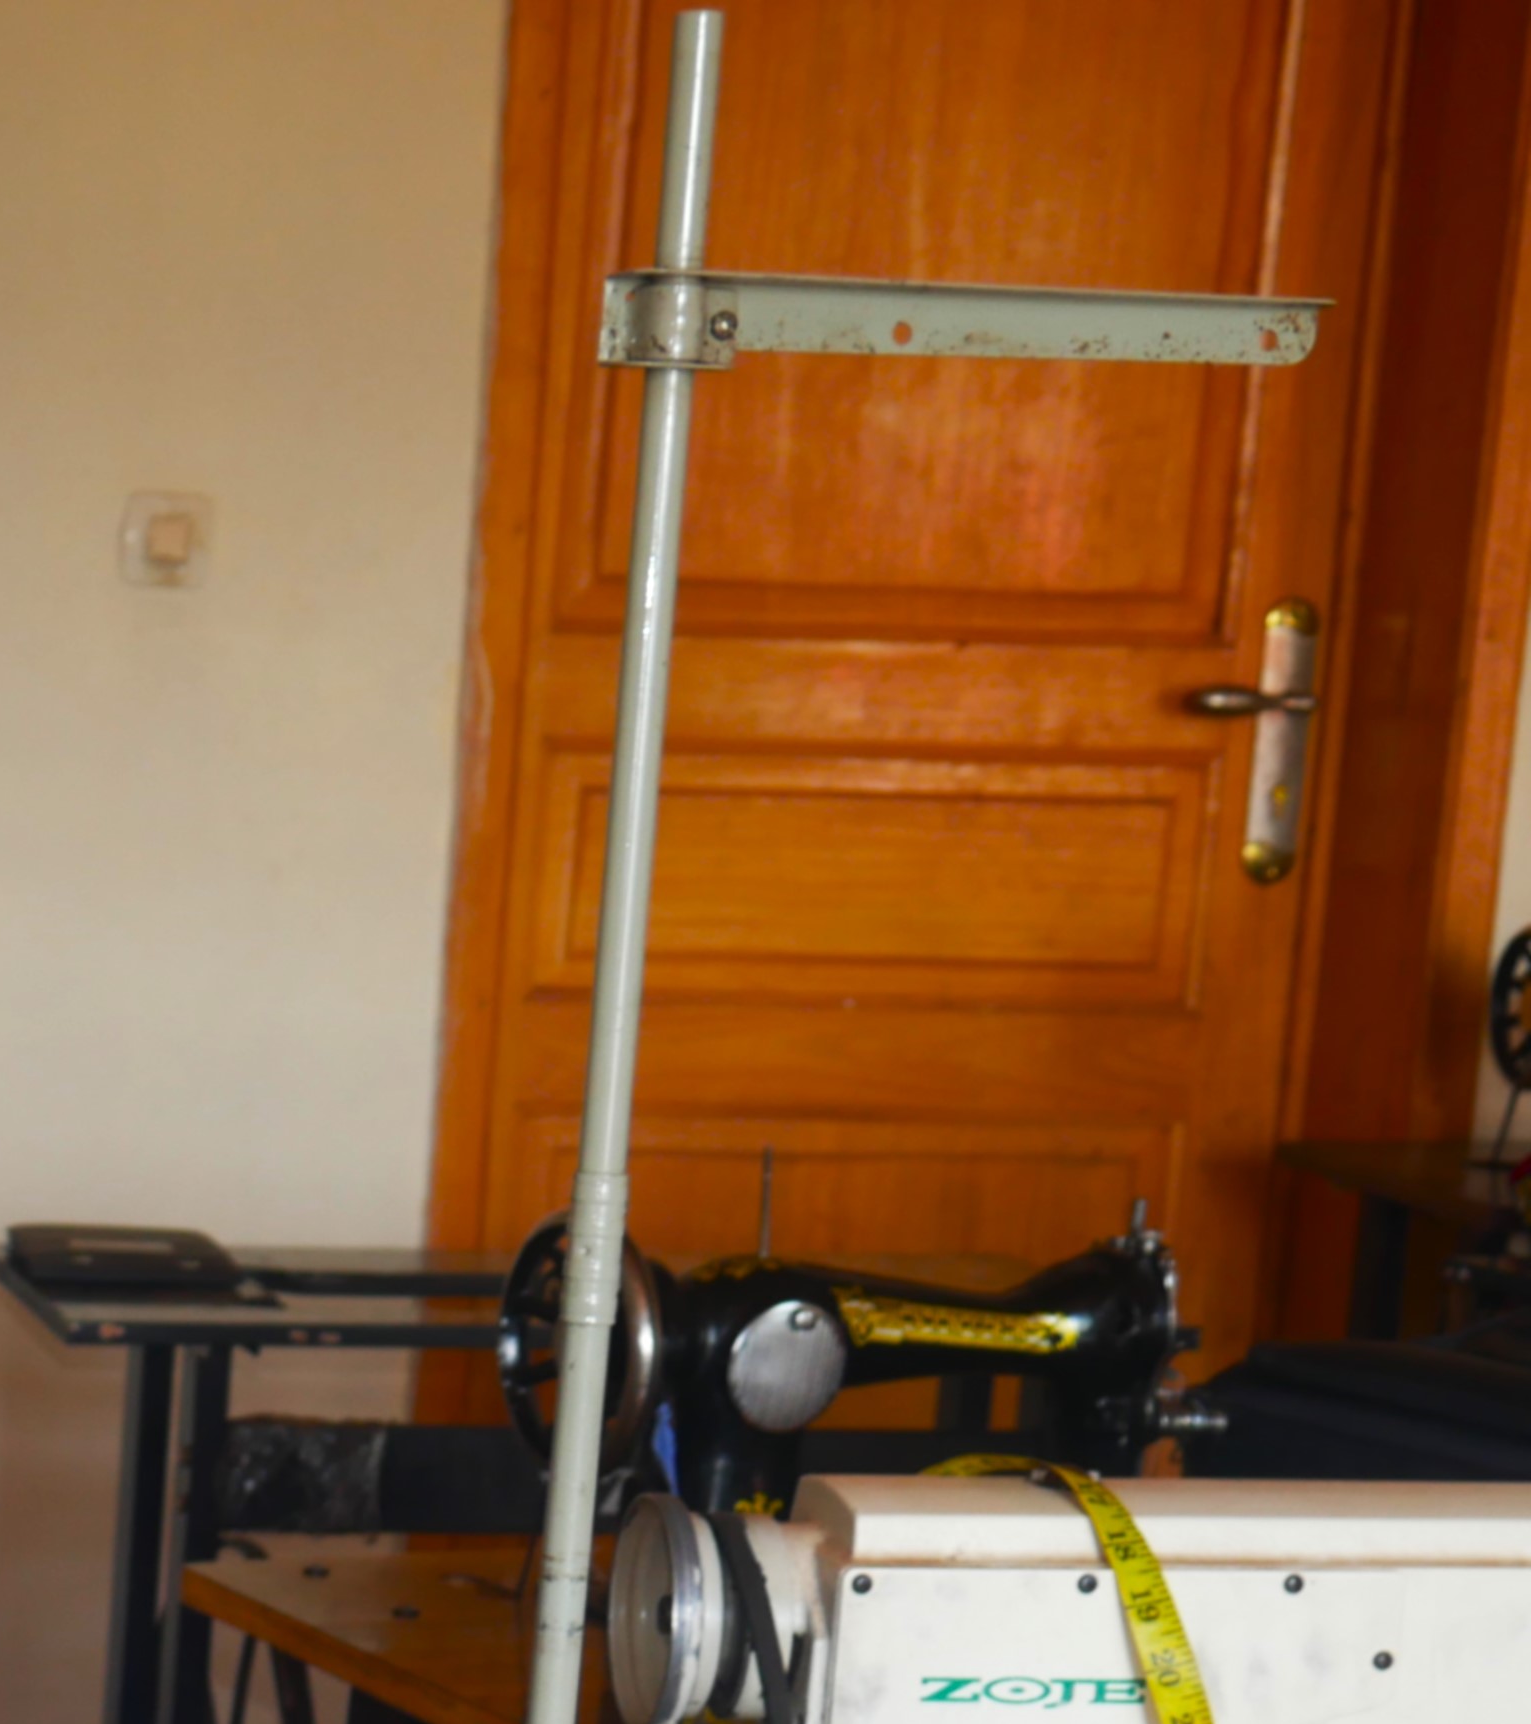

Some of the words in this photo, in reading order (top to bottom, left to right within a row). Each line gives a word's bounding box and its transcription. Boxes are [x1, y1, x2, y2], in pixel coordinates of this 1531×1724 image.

[1106, 1530, 1137, 1561] 18
[1129, 1588, 1161, 1623] 19
[1150, 1648, 1182, 1688] 20
[920, 1675, 1146, 1709] ZOJE
